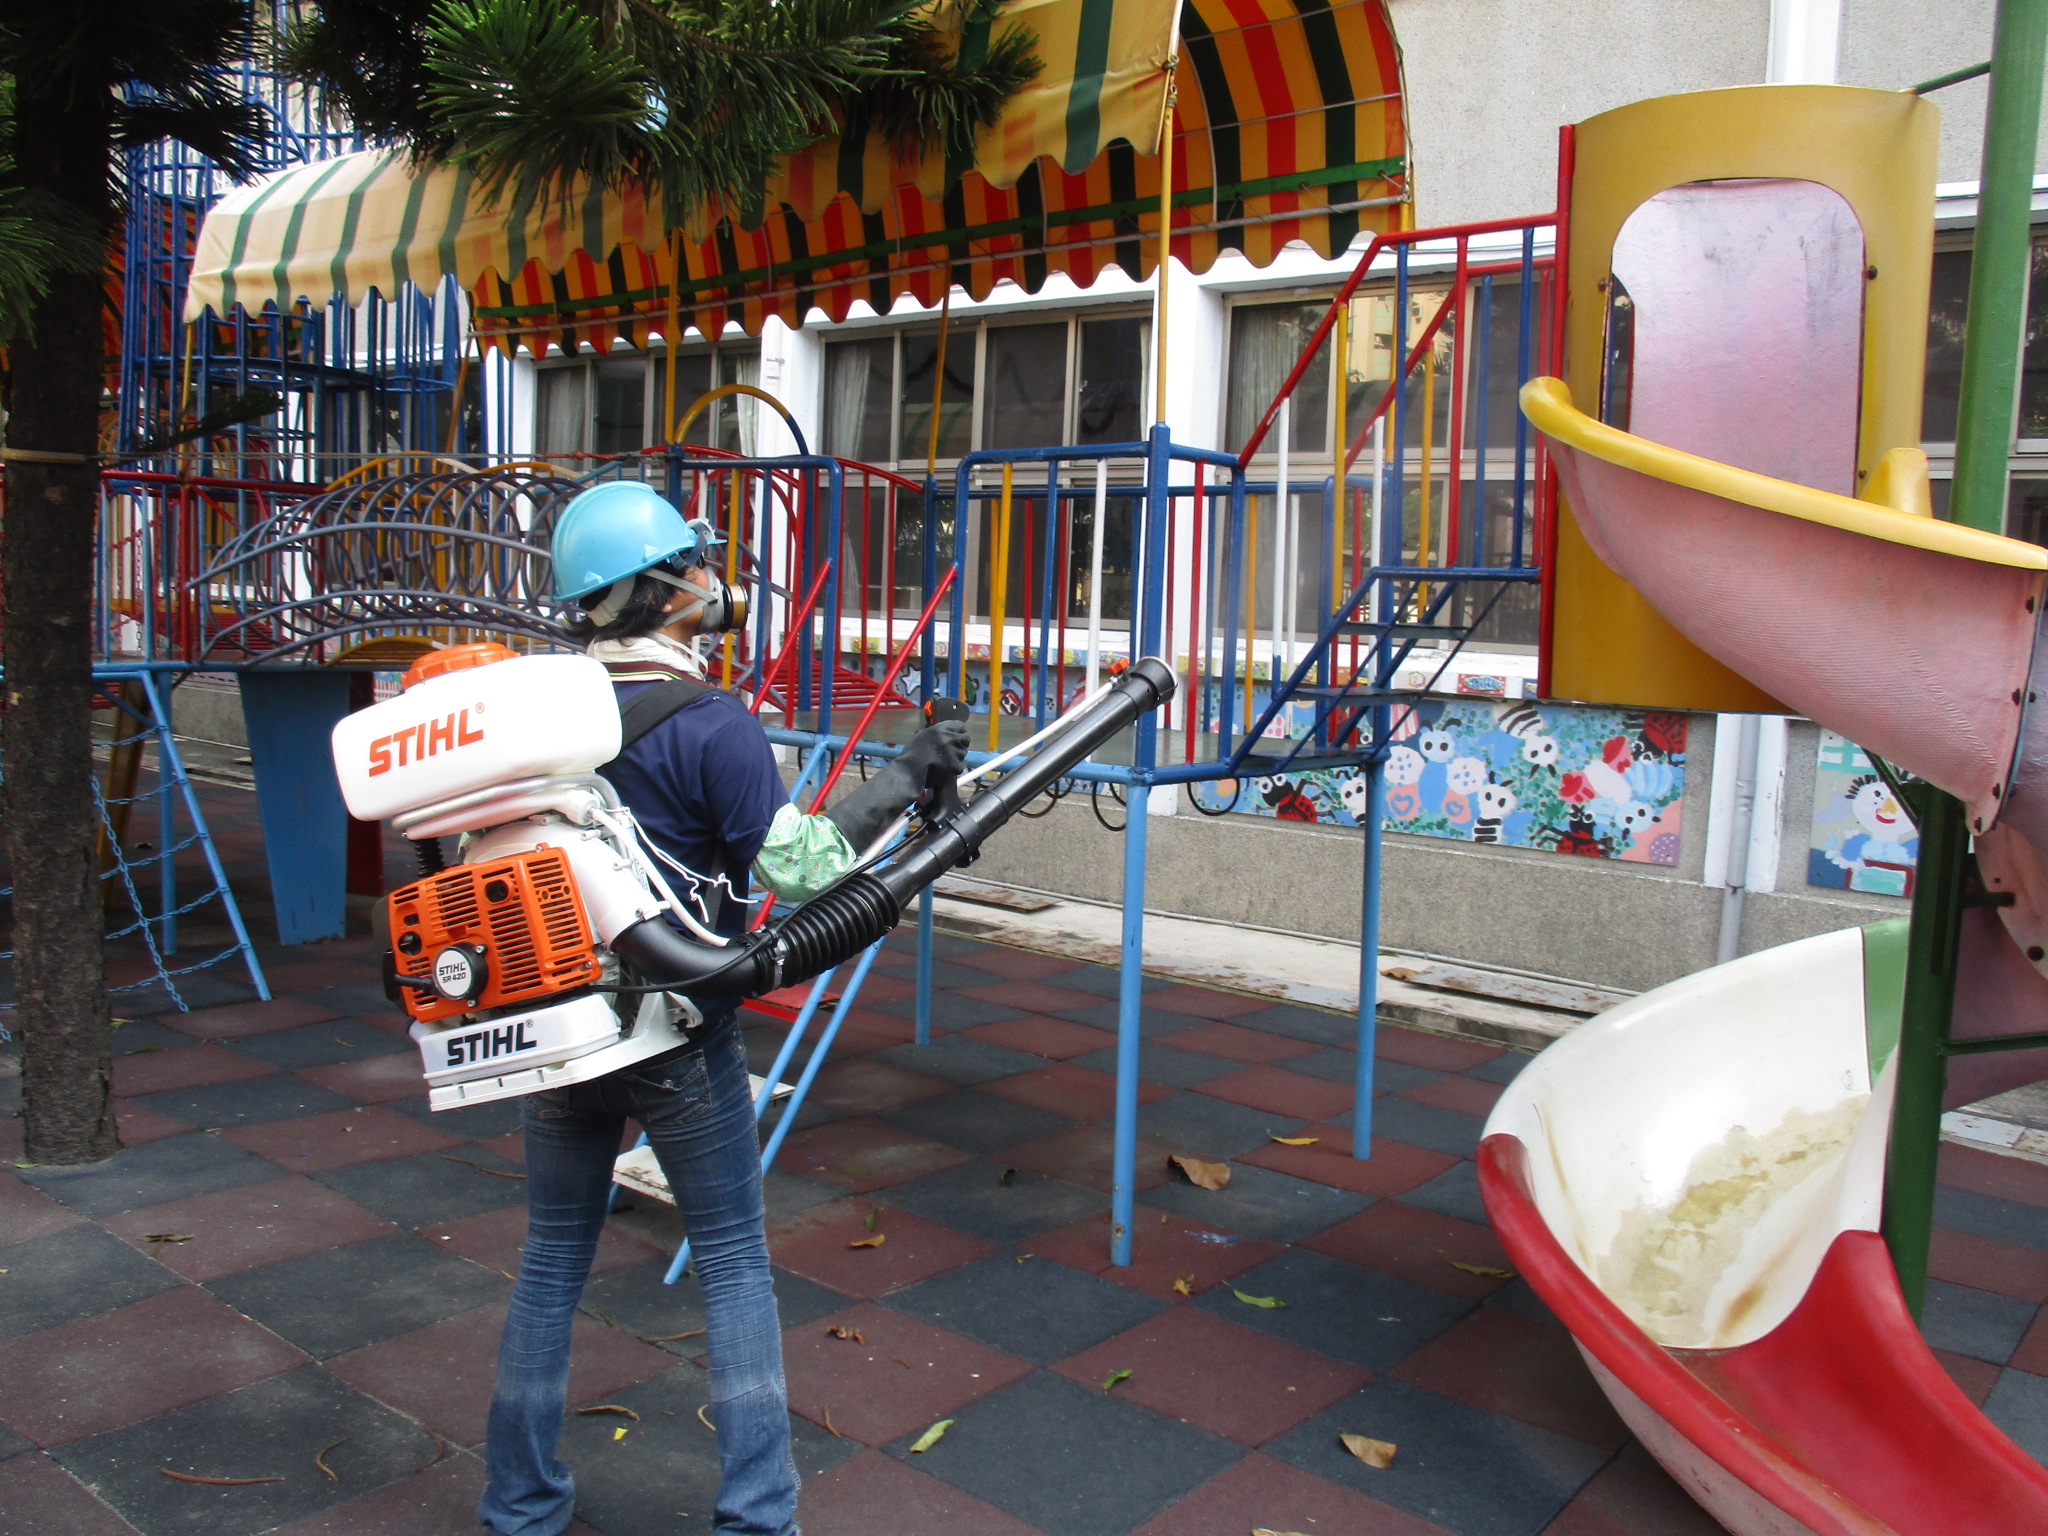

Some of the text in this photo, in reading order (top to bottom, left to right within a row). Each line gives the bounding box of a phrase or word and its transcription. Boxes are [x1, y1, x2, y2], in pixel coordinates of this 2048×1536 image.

[438, 962, 467, 977] STIHL
[442, 972, 467, 984] SR 420
